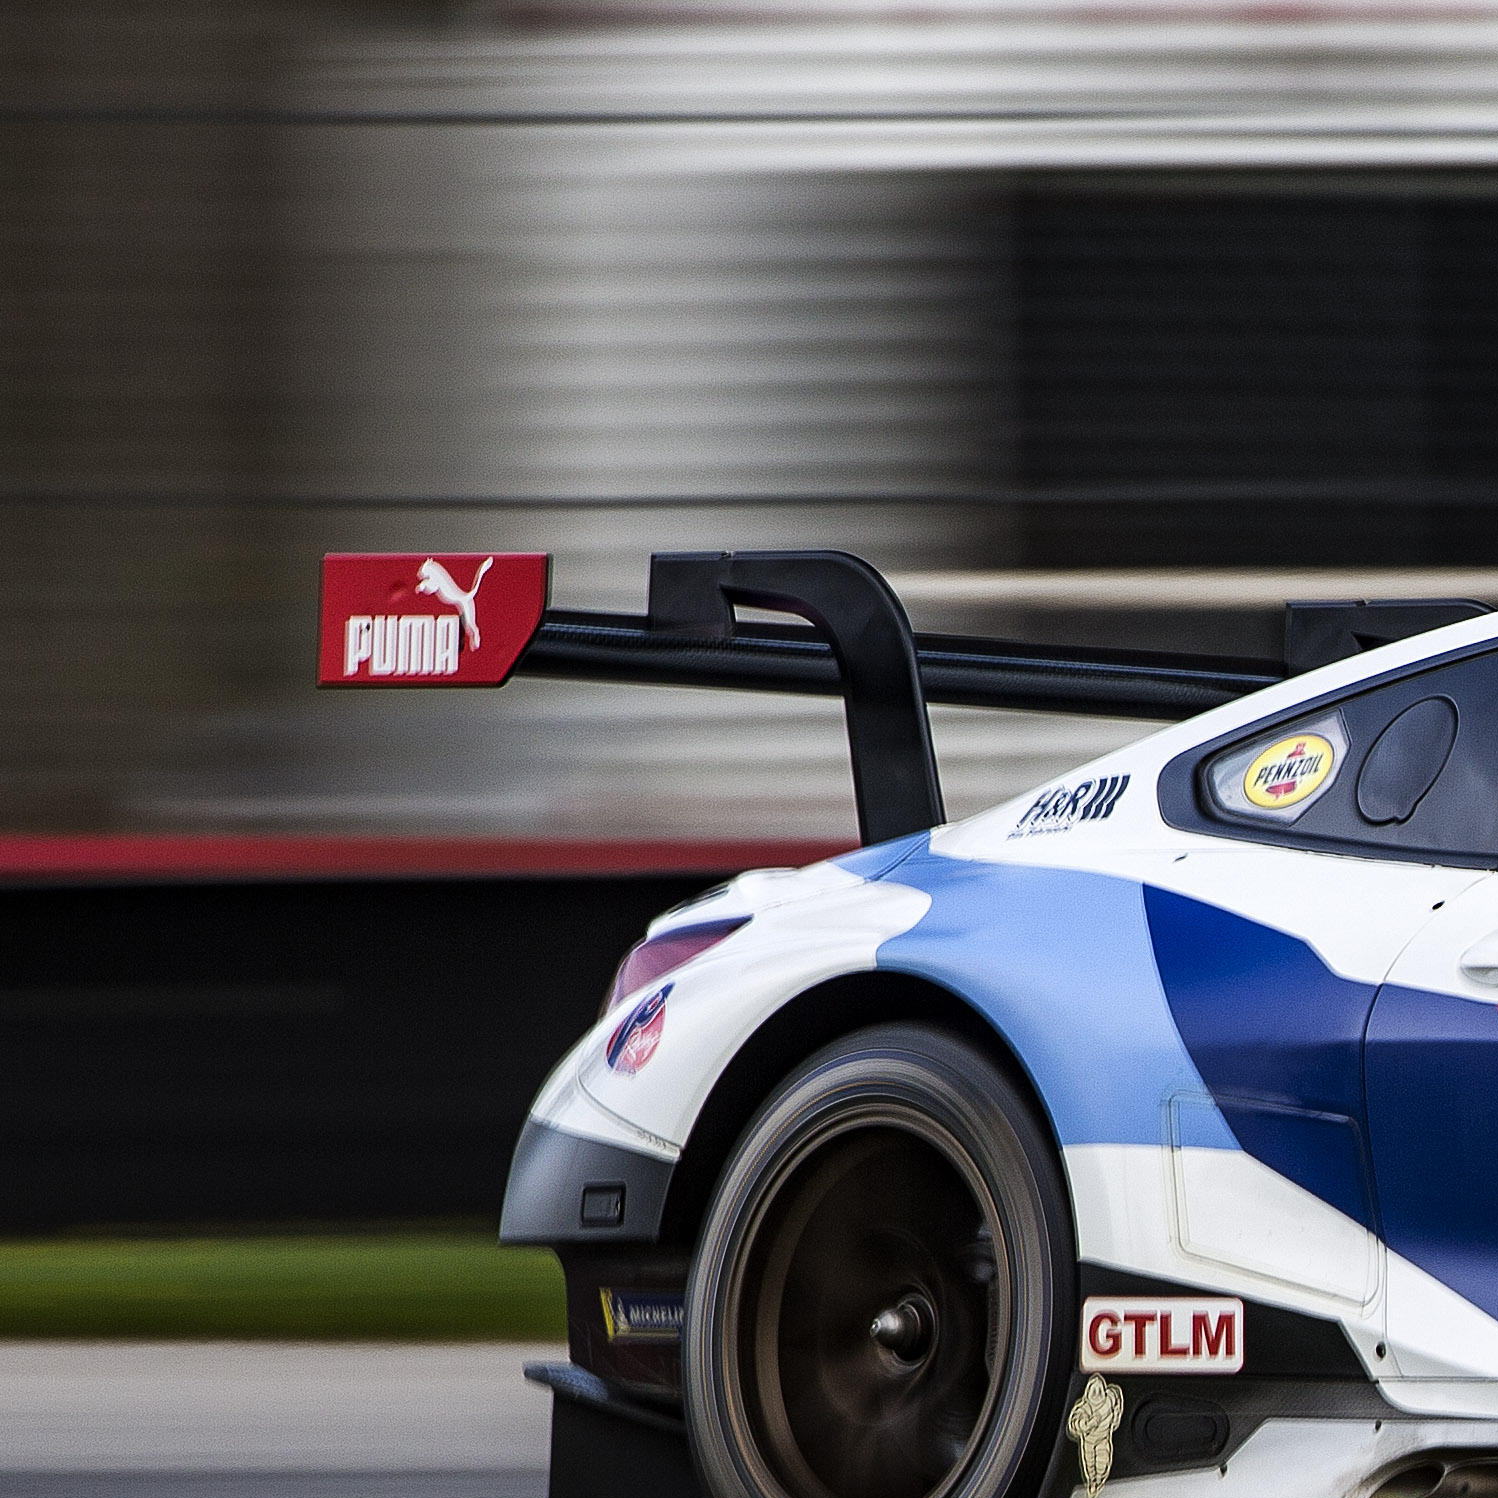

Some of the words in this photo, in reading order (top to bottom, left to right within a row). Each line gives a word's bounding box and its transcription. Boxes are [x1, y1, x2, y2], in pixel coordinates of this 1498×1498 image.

[344, 615, 460, 676] PUMA
[1252, 752, 1325, 788] PENNZOIL
[1088, 1311, 1235, 1359] GTLM
